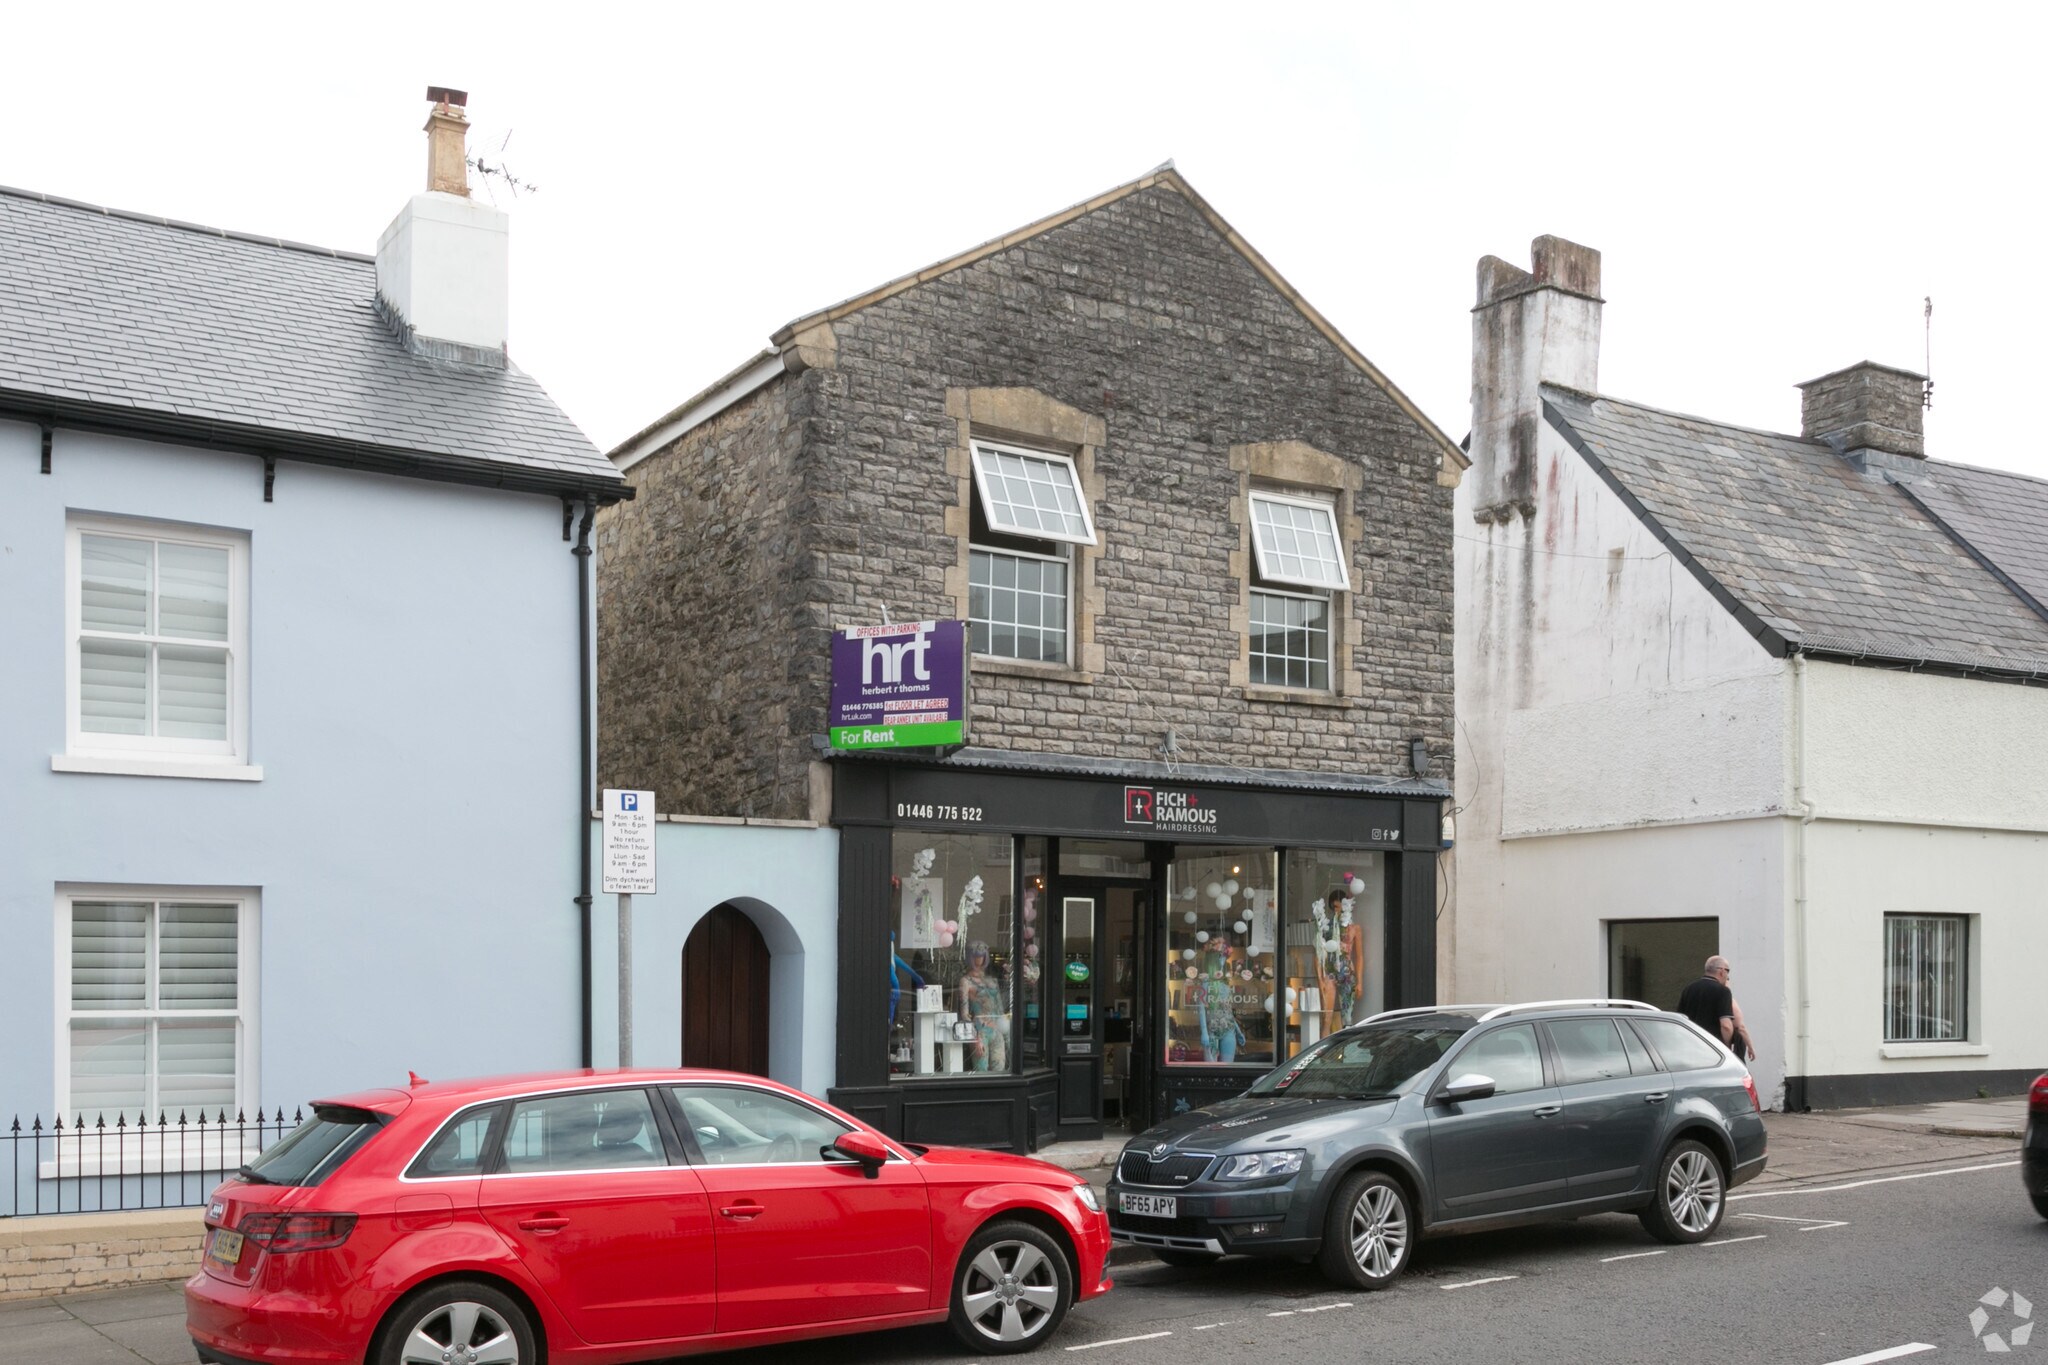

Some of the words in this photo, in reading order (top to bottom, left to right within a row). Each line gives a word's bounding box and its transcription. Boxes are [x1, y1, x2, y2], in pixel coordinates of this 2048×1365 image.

[856, 626, 880, 638] OFFICES
[880, 624, 896, 636] WITH
[896, 622, 921, 634] PARKING
[862, 632, 931, 685] hrt
[862, 685, 892, 695] herbert
[899, 683, 930, 693] thomas
[842, 702, 861, 711] 01446
[895, 700, 913, 710] FLOOR
[914, 699, 924, 709] LET
[925, 698, 948, 709] AGREED
[842, 712, 872, 721] hrt.uk.com
[841, 731, 860, 744] For
[863, 729, 894, 743] Rent
[897, 803, 934, 819] 01446
[937, 805, 958, 820] 775
[962, 806, 983, 821] 522
[1156, 807, 1216, 824] RAMOUS
[1156, 823, 1217, 833] HAIRDRESSING
[1208, 994, 1258, 1004] RAMOUS
[1126, 1195, 1150, 1212] BF65
[1153, 1198, 1174, 1214] APY
